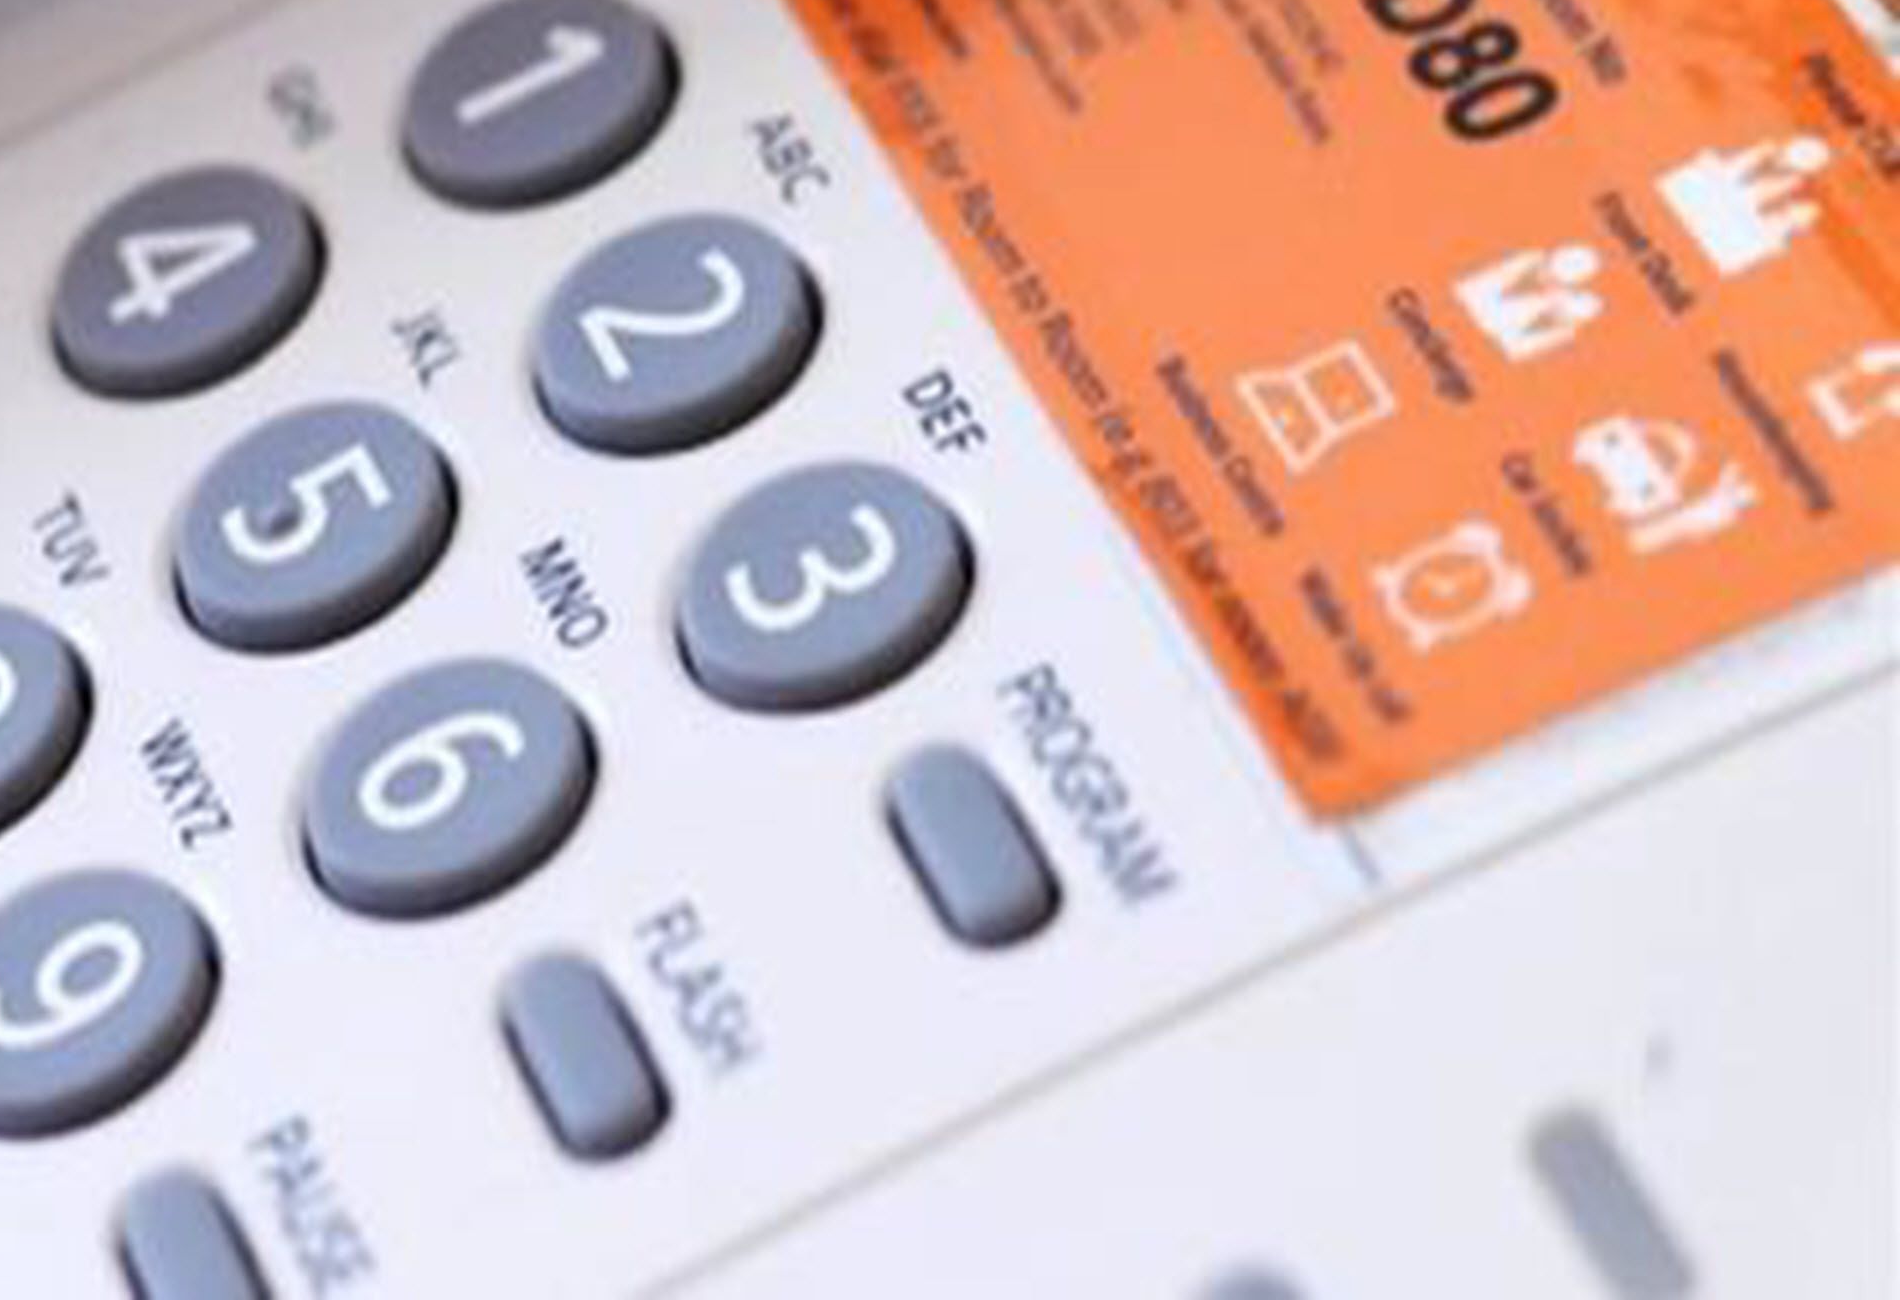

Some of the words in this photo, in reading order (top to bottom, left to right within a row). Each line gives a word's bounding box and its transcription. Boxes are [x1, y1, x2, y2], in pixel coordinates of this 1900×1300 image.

[455, 26, 606, 126] 1
[750, 114, 830, 204] ABC
[109, 222, 258, 322] 4
[578, 252, 747, 383] 2
[954, 185, 1023, 275] Room
[1039, 313, 1107, 408] Room
[391, 311, 458, 388] JKL
[902, 369, 986, 451] DEF
[33, 491, 109, 587] TUV
[221, 443, 392, 567] 5
[521, 538, 608, 648] MNO
[725, 507, 895, 632] 3
[141, 719, 232, 849] WXYZ
[360, 712, 524, 830] 6
[998, 663, 1181, 910] PROGRAM
[635, 903, 760, 1079] FLASH
[247, 1115, 378, 1292] PAUSE
